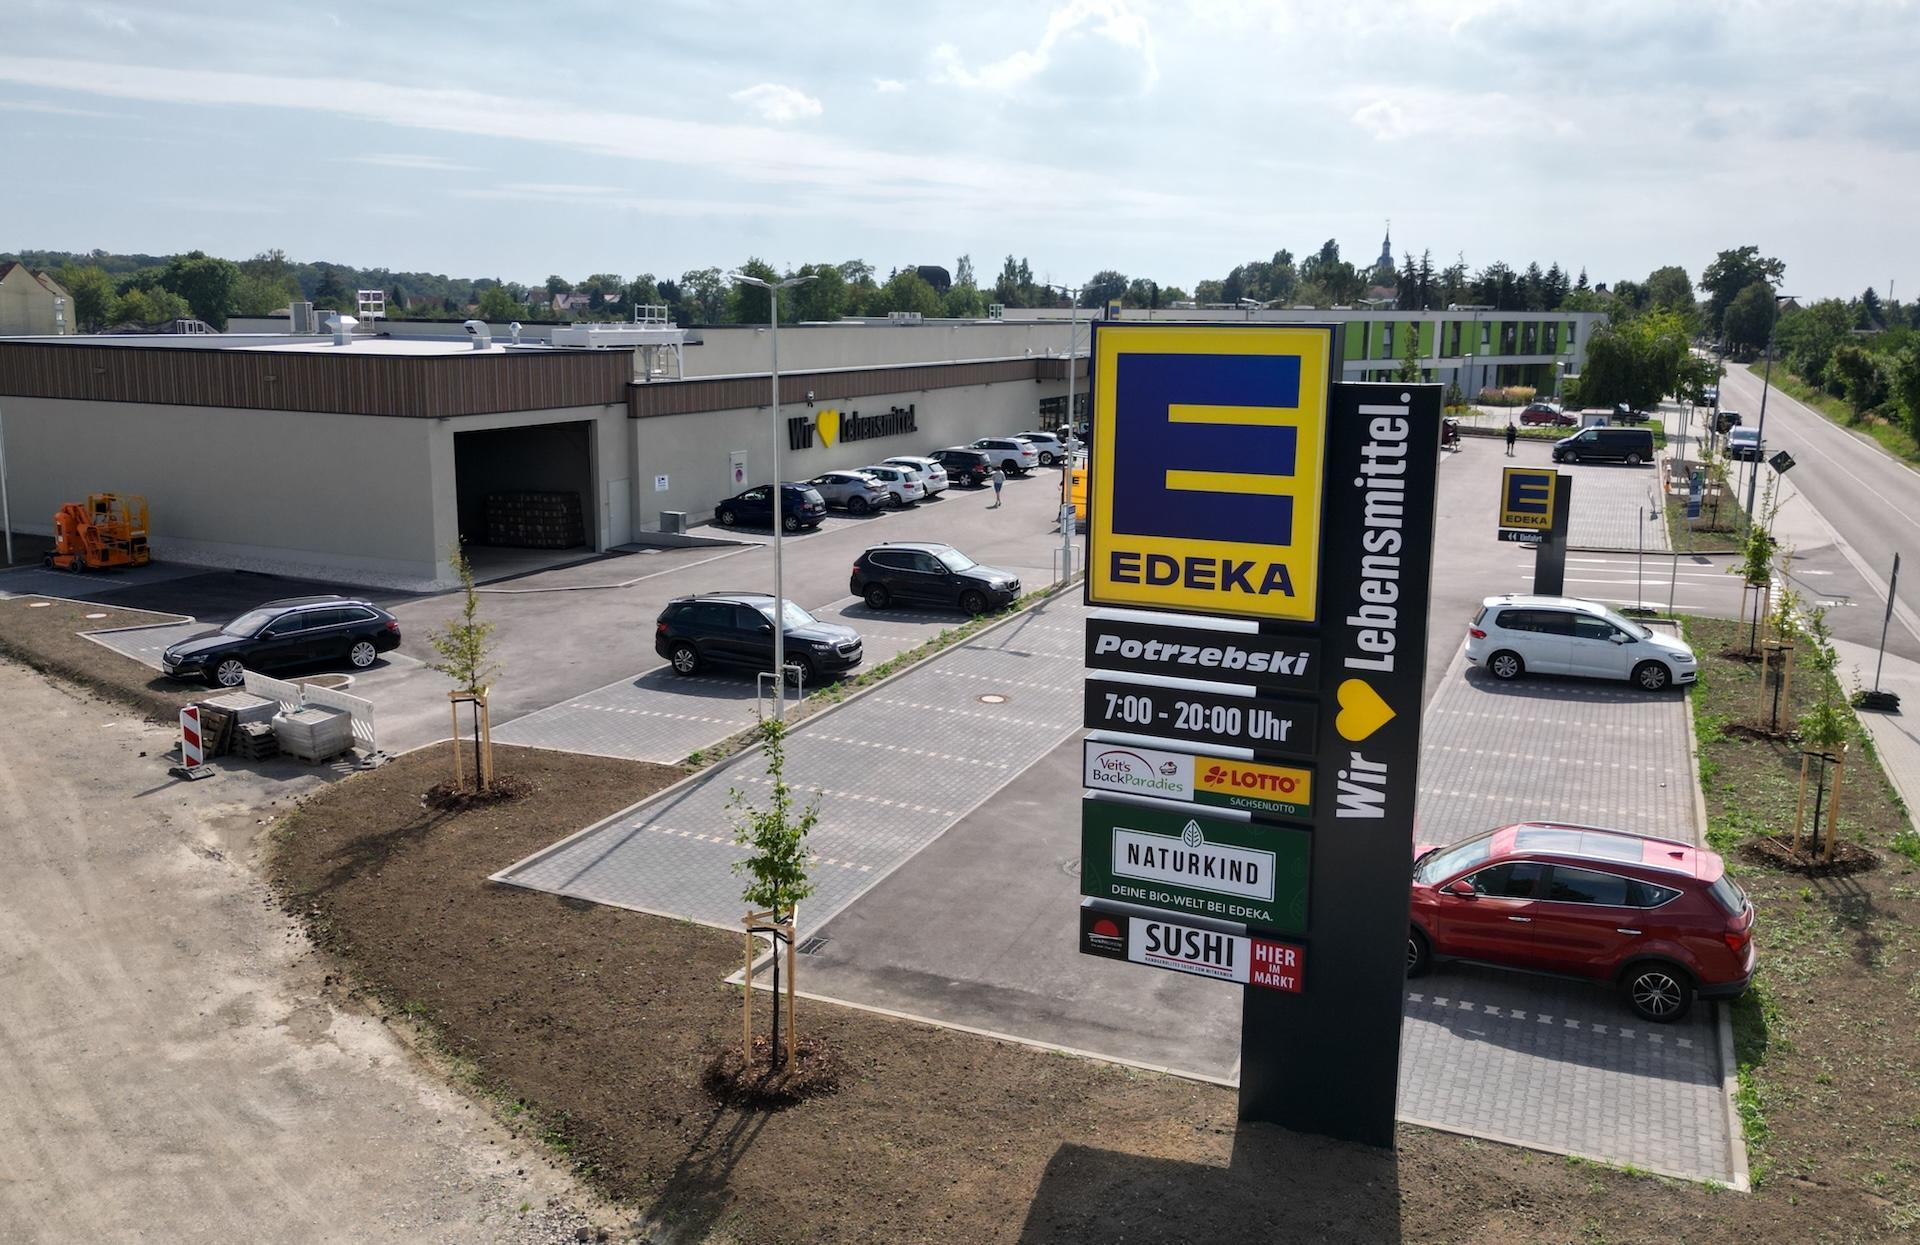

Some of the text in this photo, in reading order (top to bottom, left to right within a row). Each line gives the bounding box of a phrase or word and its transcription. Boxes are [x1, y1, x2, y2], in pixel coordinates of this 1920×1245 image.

[788, 416, 816, 450] Wir
[1505, 515, 1547, 525] EDEKA
[1110, 551, 1295, 597] EDEKA
[1336, 392, 1412, 818] Wir Lebensmittel.
[1095, 634, 1311, 677] Potrzebski
[1104, 693, 1293, 742] 7:00 - 20:00 Uhr
[1093, 769, 1184, 793] BackParadies
[1100, 758, 1131, 772] Veit's
[1230, 796, 1295, 814] SACHSENLOTTO
[1127, 843, 1259, 885] NATURKIND
[1111, 884, 1273, 922] DEINE BIO-WELT BEI EDEKA.
[1145, 923, 1234, 967] SUSHI
[1255, 944, 1296, 967] HIER
[1254, 970, 1295, 989] MARKT
[1269, 964, 1280, 974] IM
